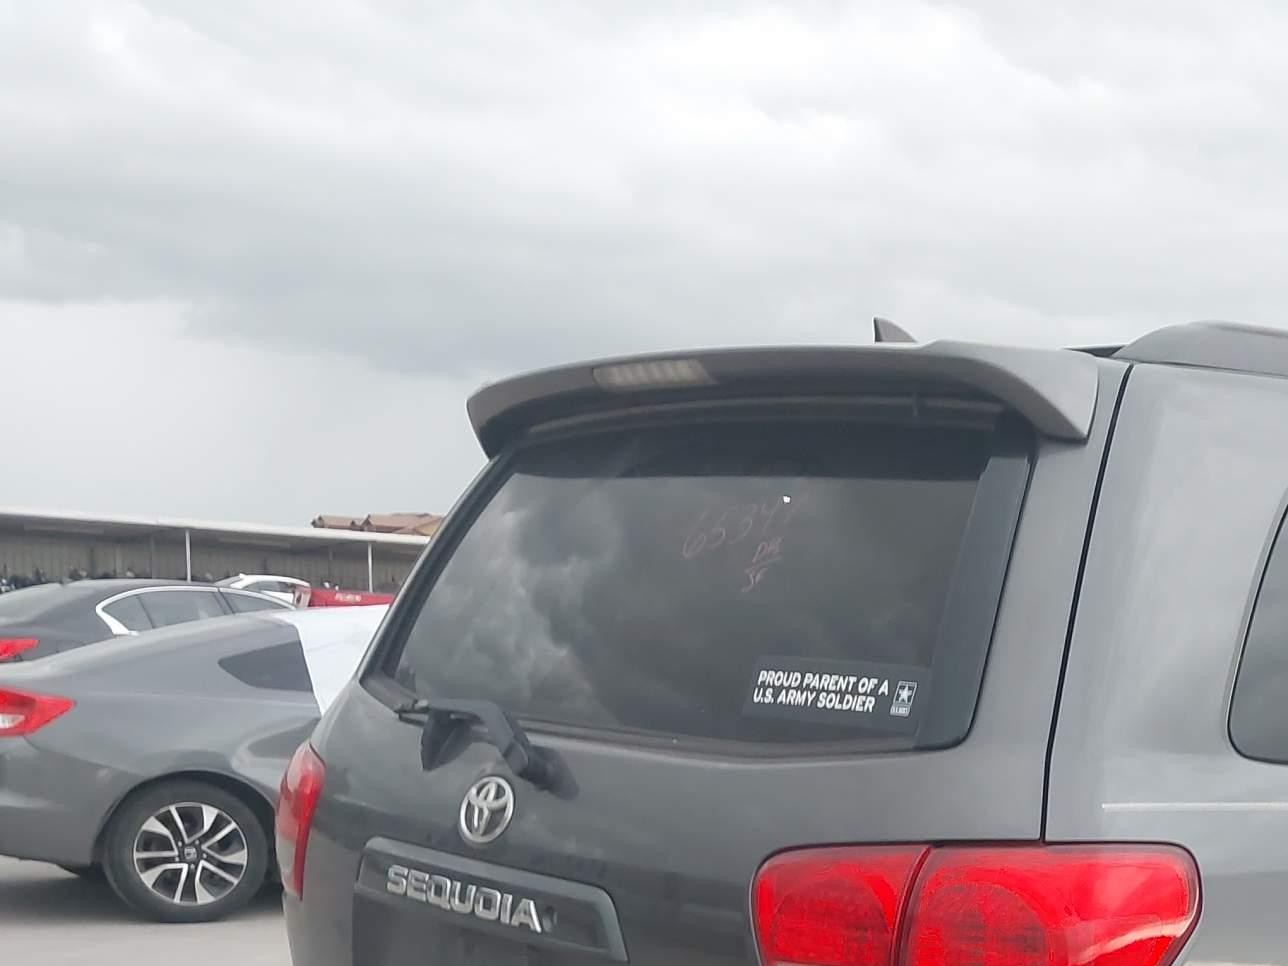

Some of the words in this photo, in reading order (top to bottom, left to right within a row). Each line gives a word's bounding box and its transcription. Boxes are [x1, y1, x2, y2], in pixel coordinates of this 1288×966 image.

[757, 670, 801, 688] PROUD
[802, 673, 857, 693] PARENT
[858, 677, 878, 694] OF
[878, 679, 889, 696] A
[752, 687, 774, 704] U.S.
[776, 689, 816, 707] ARMY
[816, 692, 876, 713] SOLDIER
[386, 864, 542, 934] SEQUOIA
